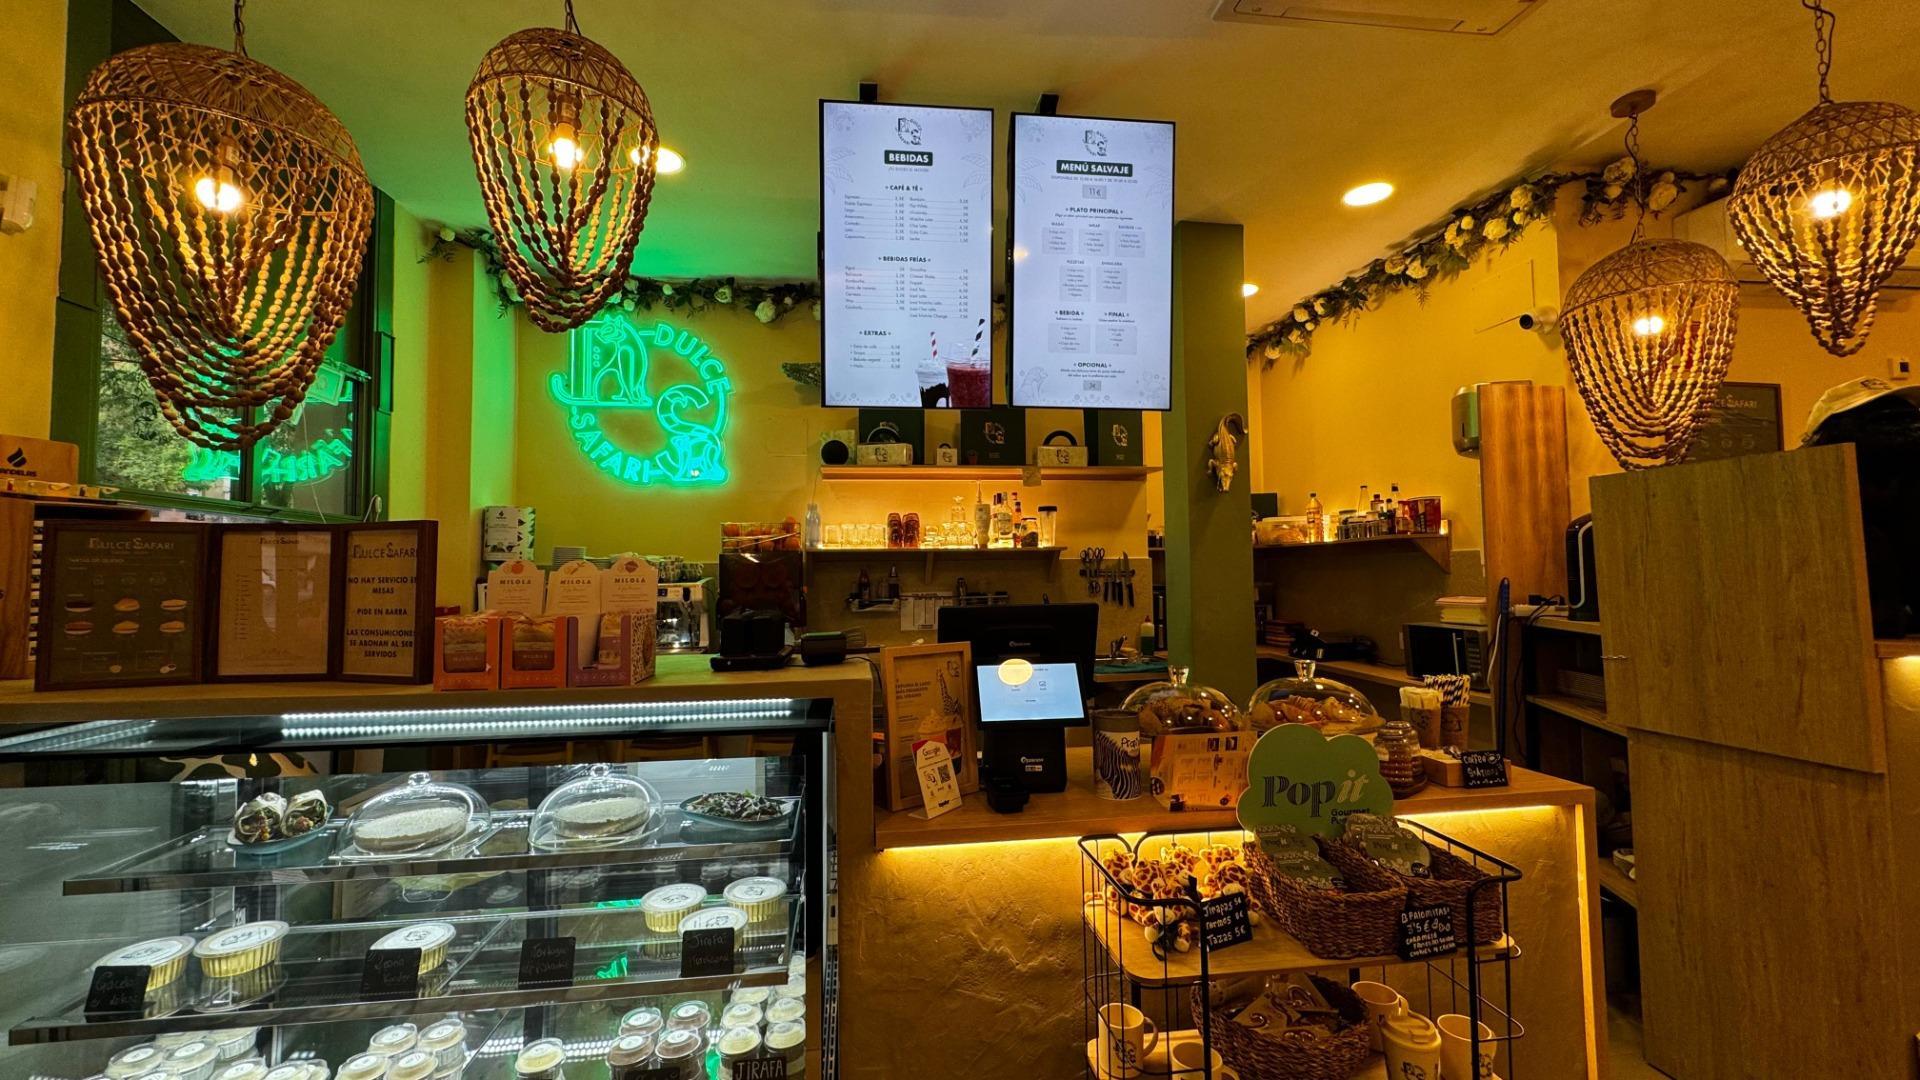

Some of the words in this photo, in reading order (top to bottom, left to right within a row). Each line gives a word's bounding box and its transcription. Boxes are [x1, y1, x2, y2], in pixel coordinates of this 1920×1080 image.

[888, 152, 929, 163] BEBIDAS
[1060, 162, 1089, 172] MENÚ
[1091, 164, 1129, 174] SALVAJE
[909, 255, 927, 263] FRÍAS
[654, 324, 731, 395] DULCE
[571, 412, 649, 483] SAFARI
[373, 608, 383, 616] EN
[364, 650, 397, 658] SERVIDOS
